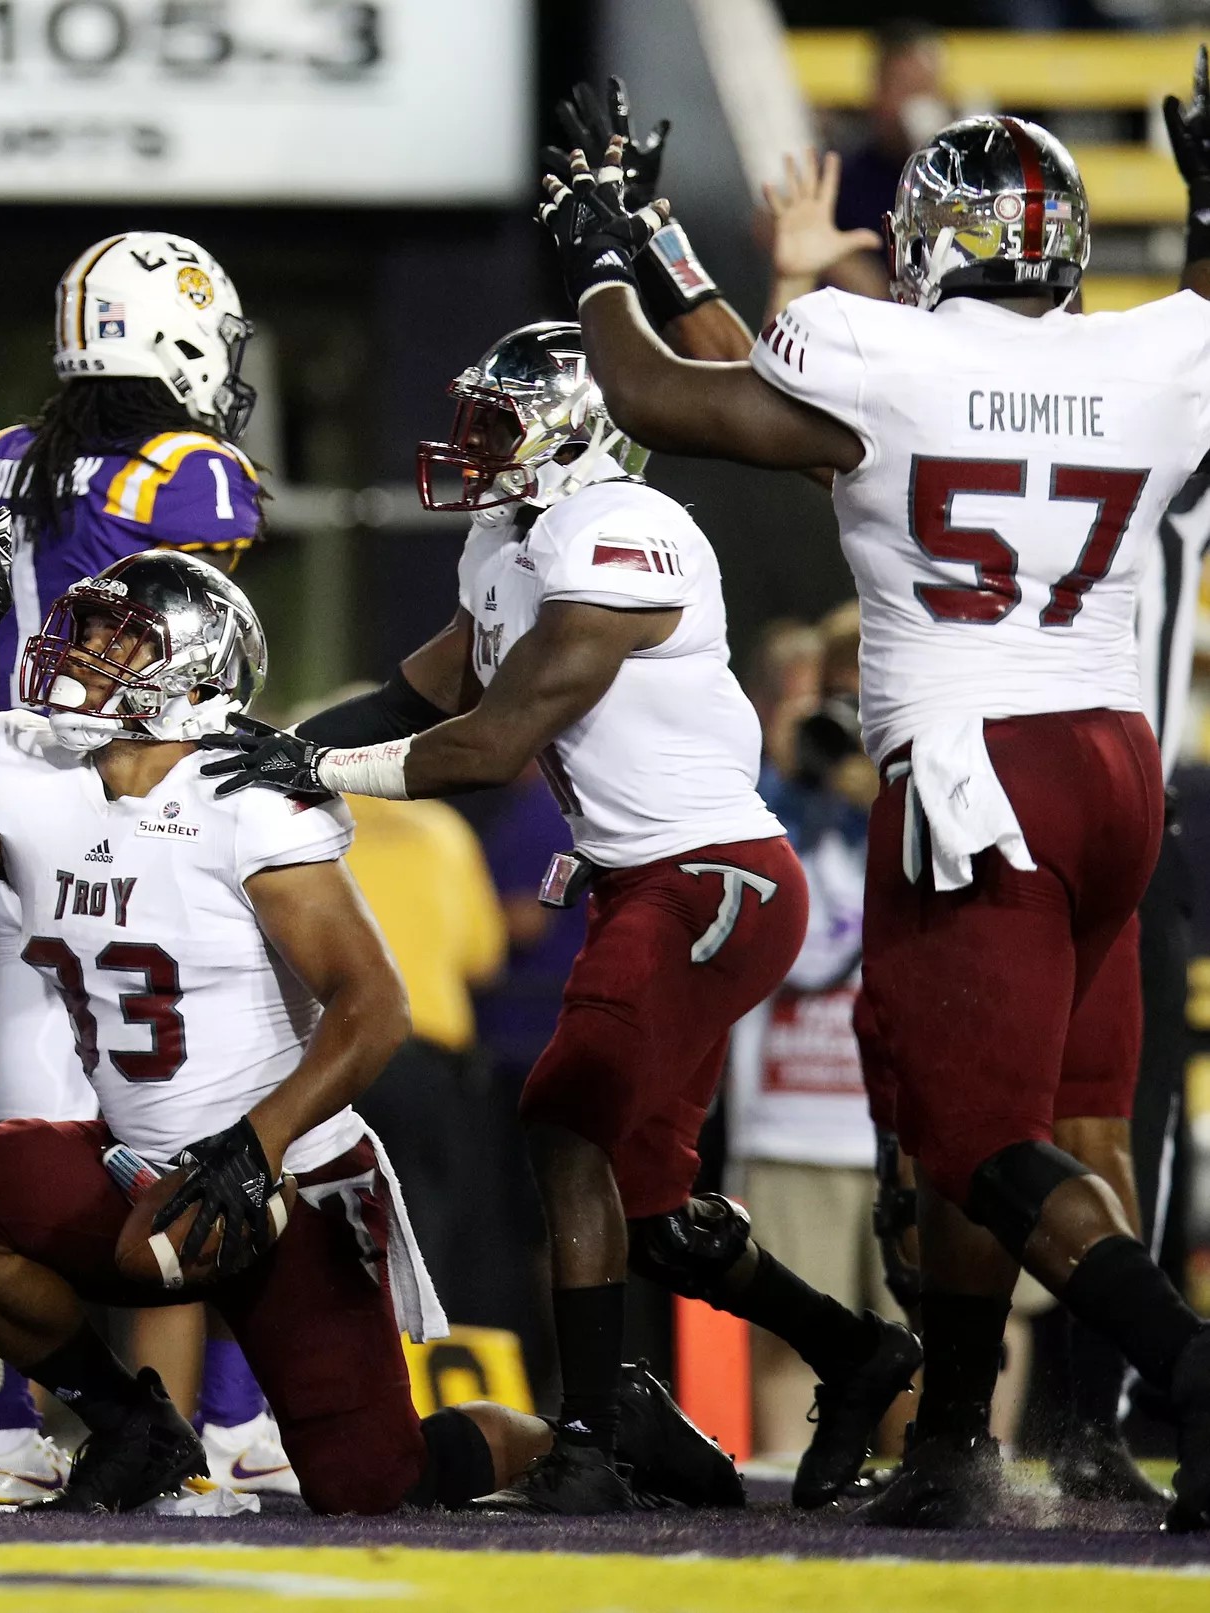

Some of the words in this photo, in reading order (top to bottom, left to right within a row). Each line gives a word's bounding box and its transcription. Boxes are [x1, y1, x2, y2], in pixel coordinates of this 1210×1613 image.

[1015, 260, 1052, 282] TROY
[969, 390, 1104, 437] CRUMITIE
[207, 457, 235, 520] 1
[907, 453, 1152, 628] 57
[84, 851, 114, 864] adidas
[54, 869, 138, 927] TROY
